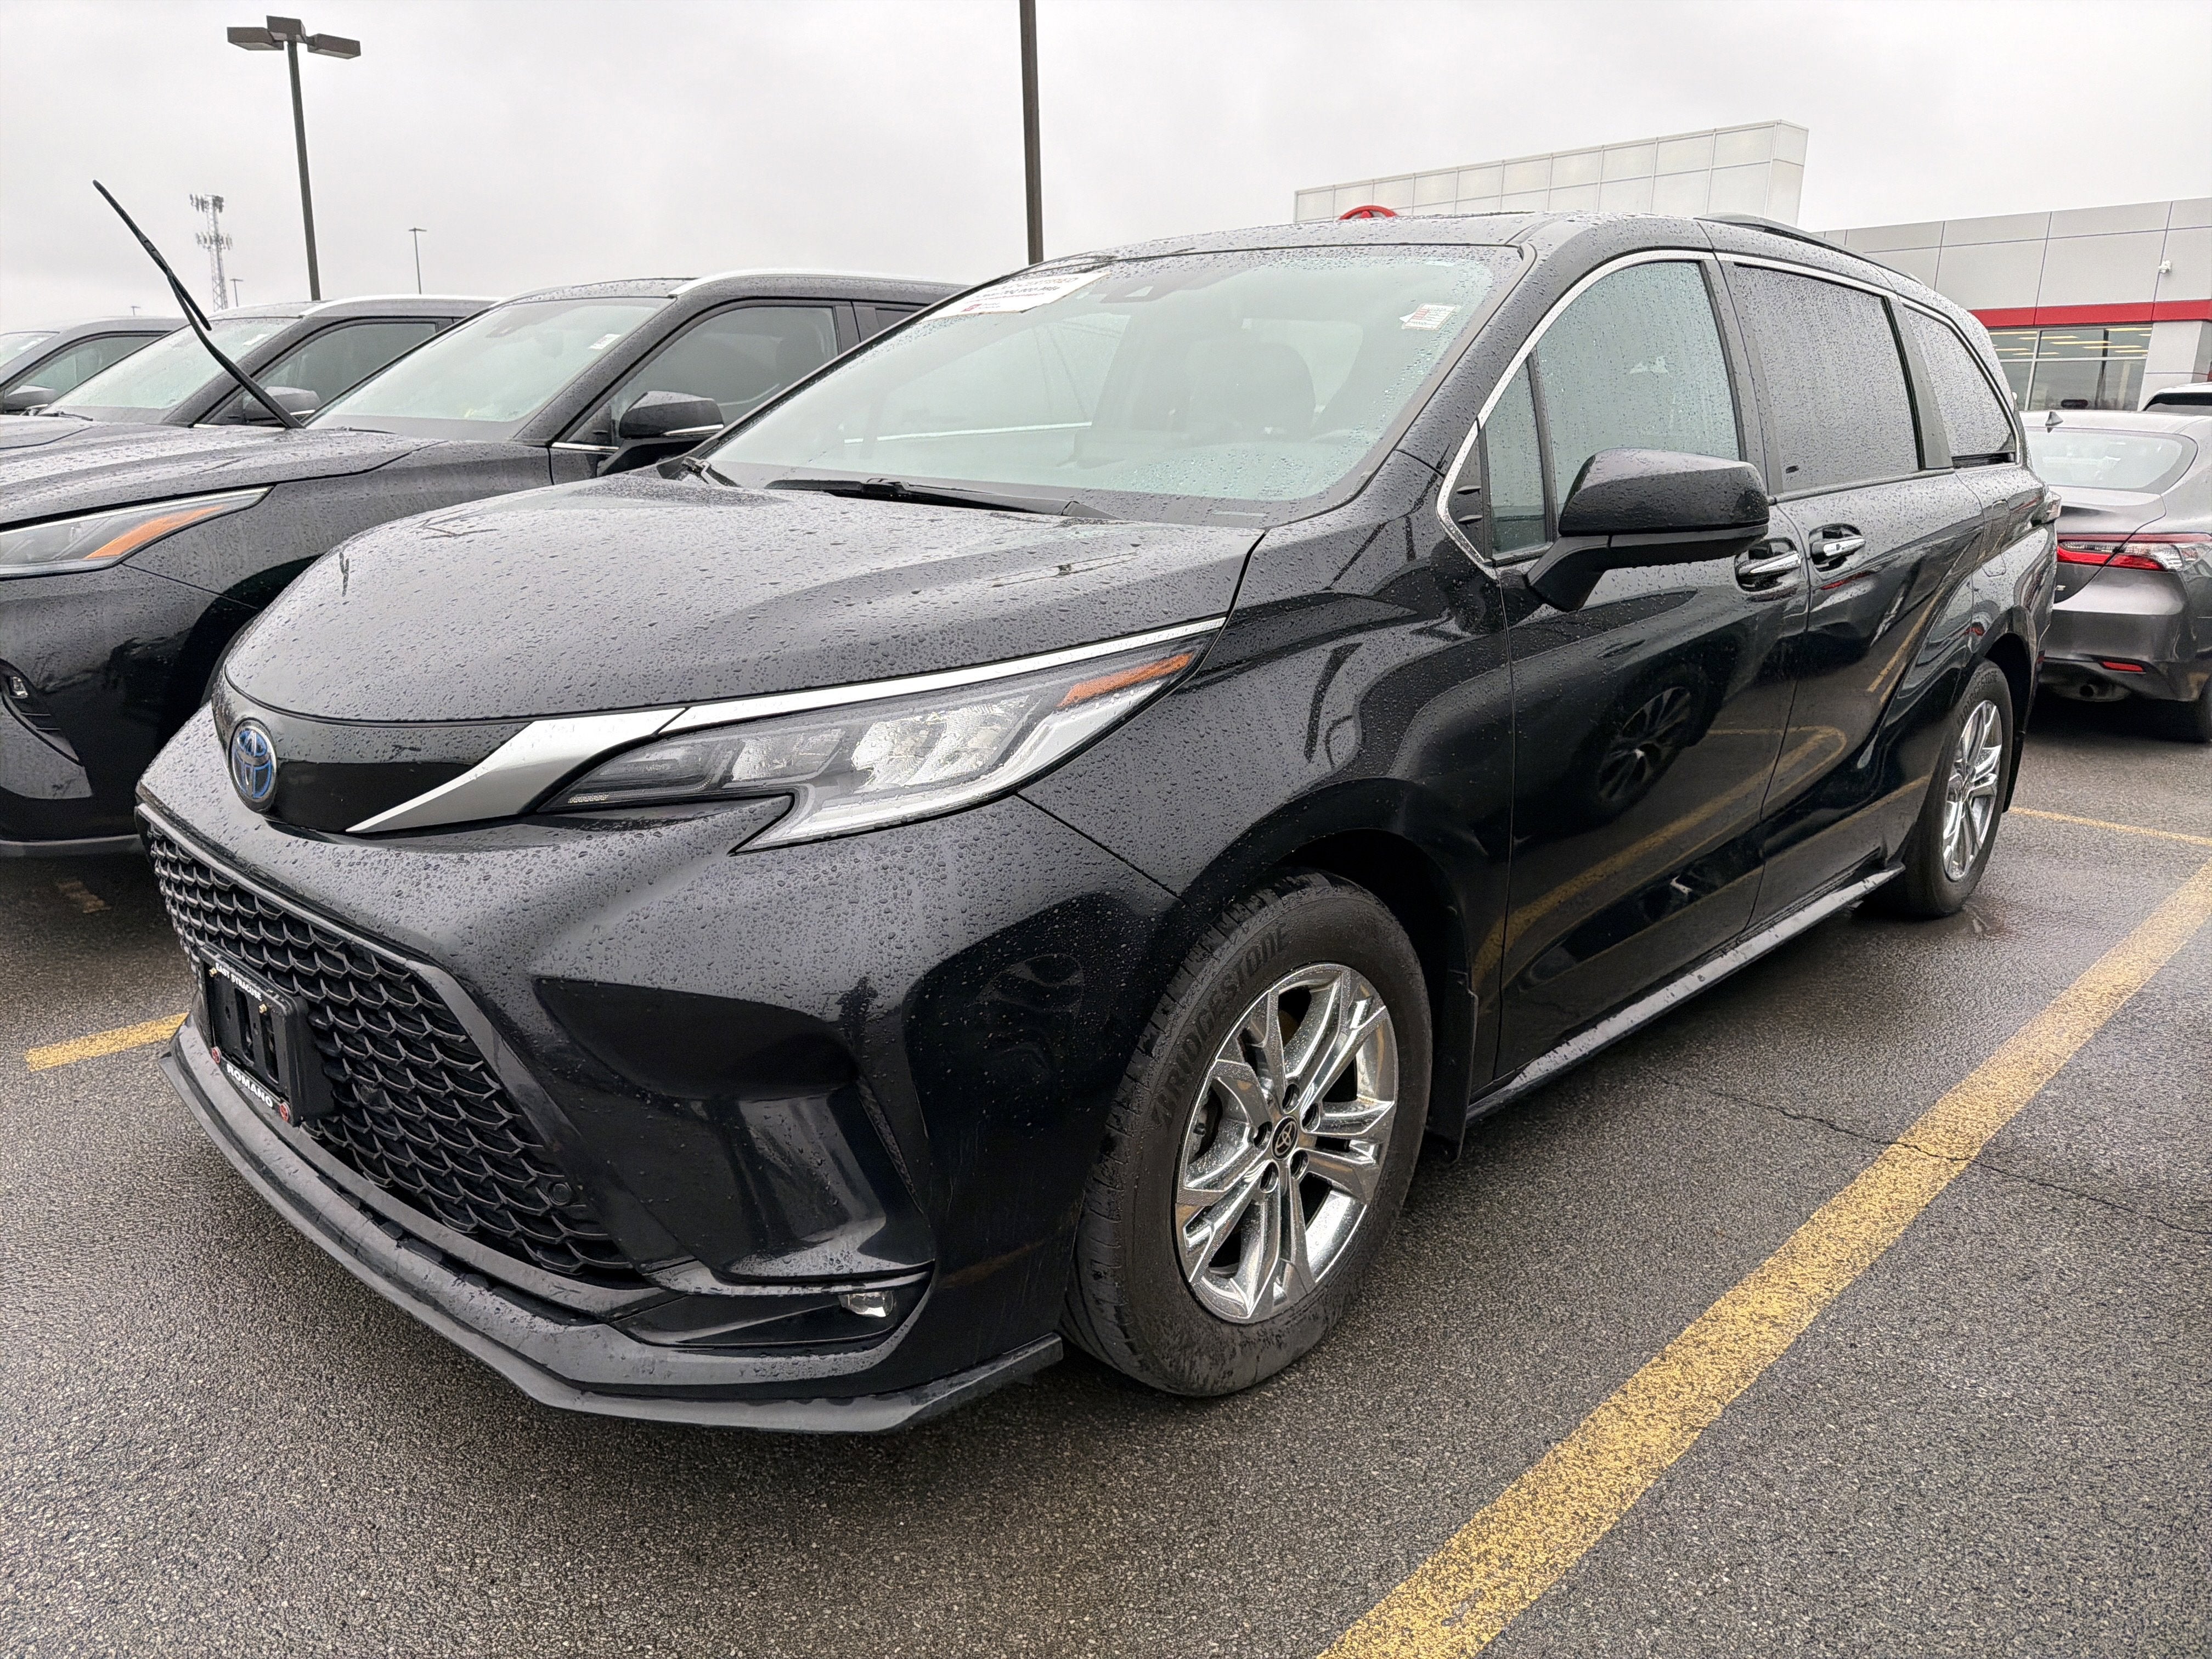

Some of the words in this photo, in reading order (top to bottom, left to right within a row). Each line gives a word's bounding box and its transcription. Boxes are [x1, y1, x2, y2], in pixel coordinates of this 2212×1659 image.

[215, 962, 230, 979] EAST
[230, 973, 262, 1002] SYRACUSE
[226, 1063, 273, 1108] ROMANO
